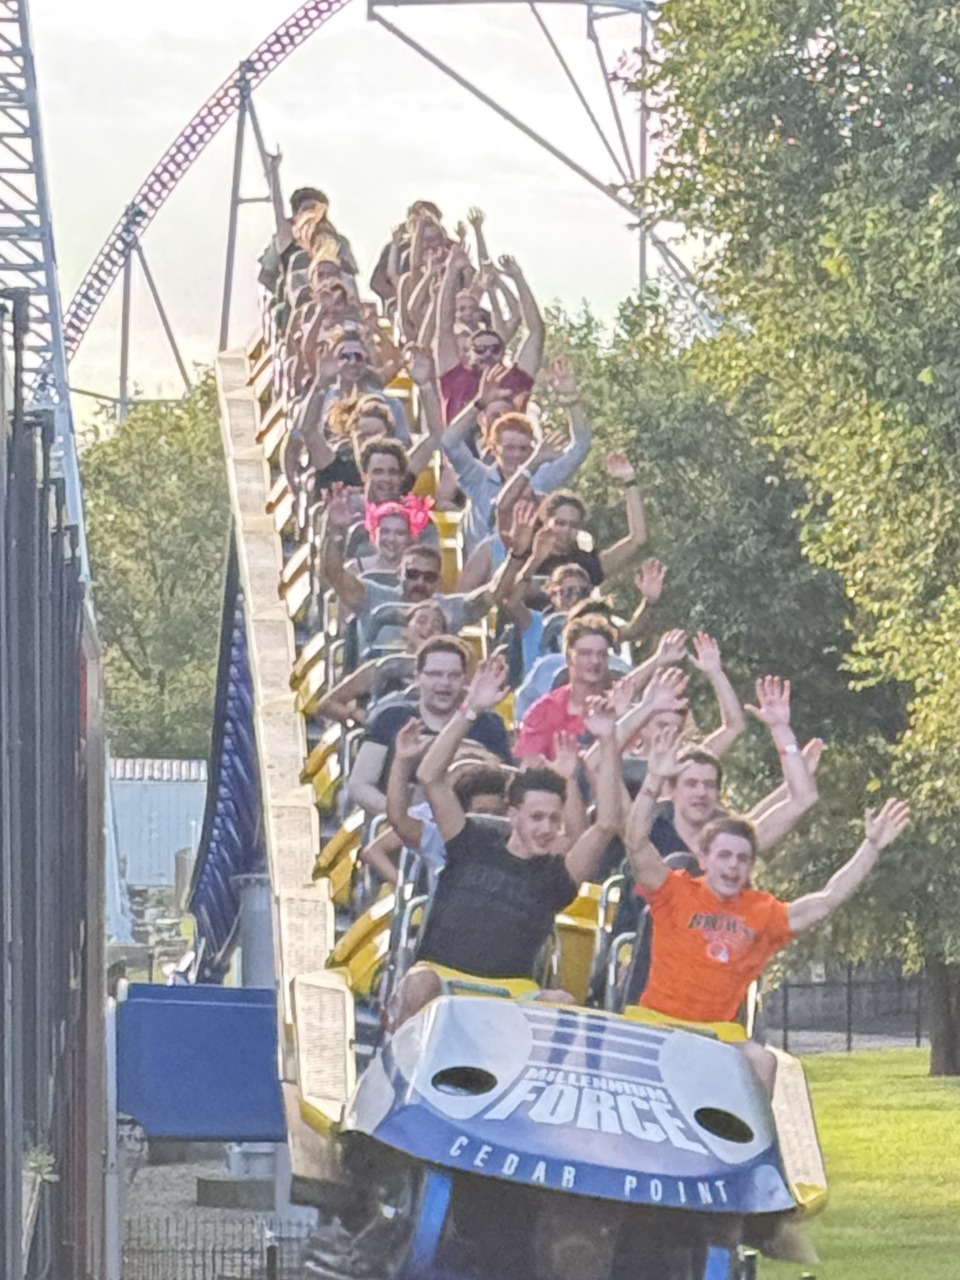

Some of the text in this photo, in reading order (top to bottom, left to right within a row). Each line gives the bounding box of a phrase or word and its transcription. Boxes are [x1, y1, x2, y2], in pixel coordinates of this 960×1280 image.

[483, 1080, 710, 1155] FORCE
[524, 1067, 669, 1103] MILLENNIUM
[449, 1135, 728, 1205] CEDAR POINT
